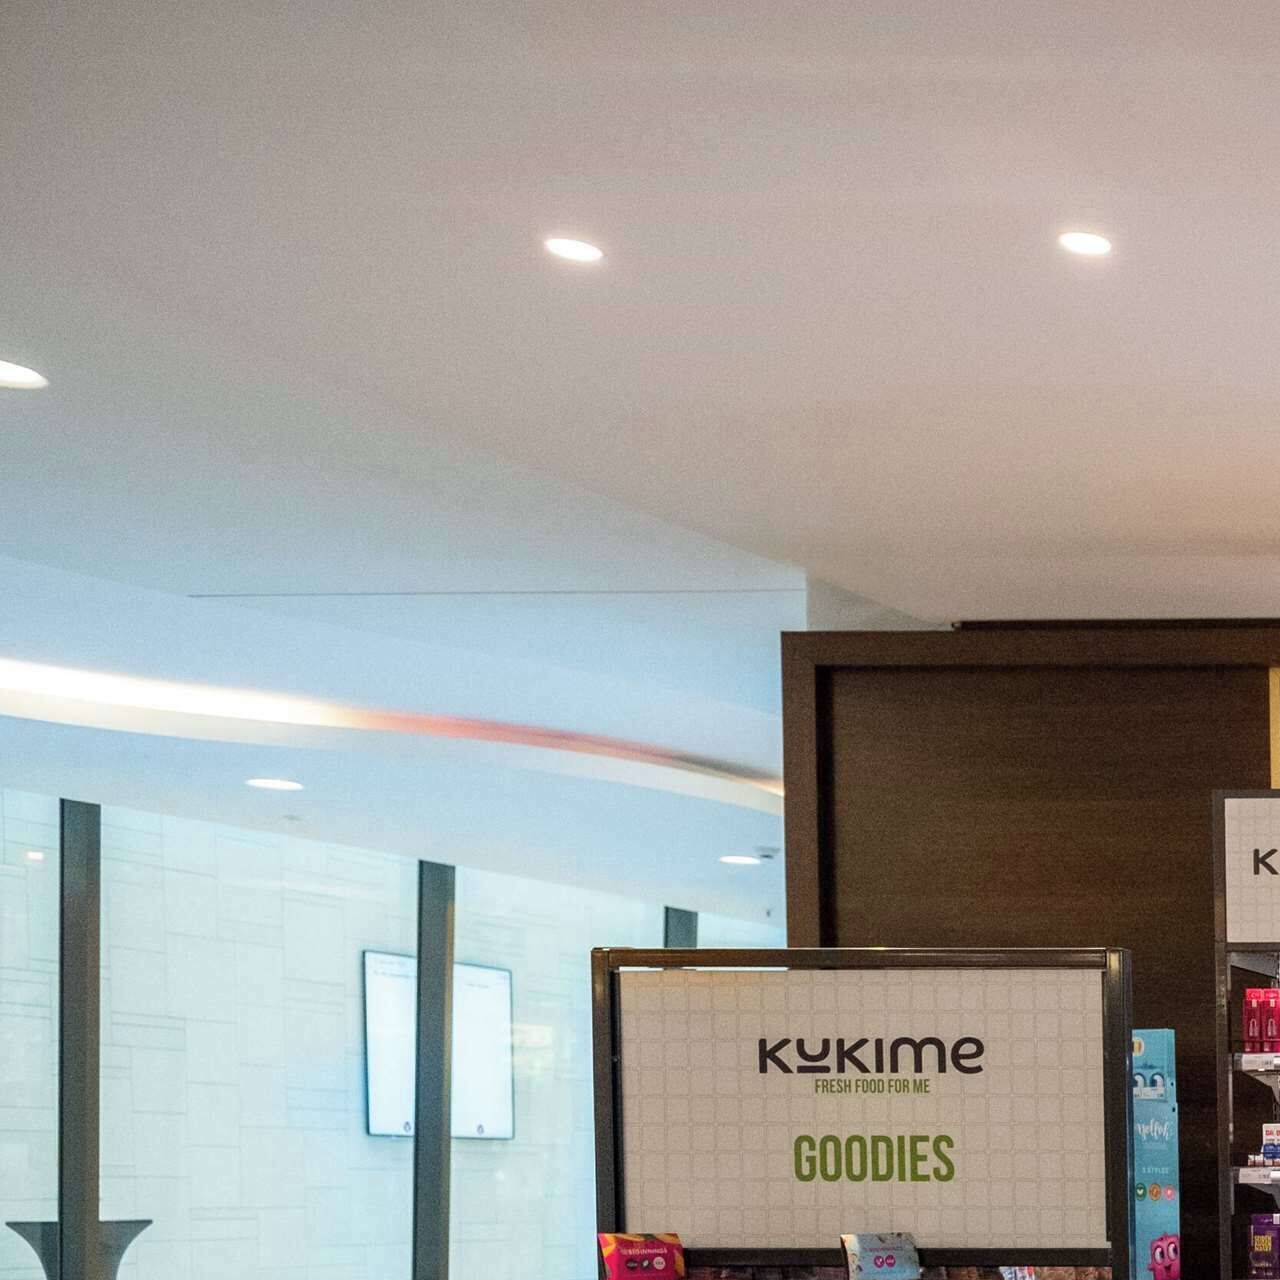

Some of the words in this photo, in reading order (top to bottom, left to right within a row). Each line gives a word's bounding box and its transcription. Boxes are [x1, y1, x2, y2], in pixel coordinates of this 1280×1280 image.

[814, 1078, 852, 1094] FRESH
[854, 1078, 885, 1094] FOOD
[887, 1078, 910, 1094] FOR
[913, 1078, 931, 1094] ME
[793, 1134, 955, 1183] GOODIES
